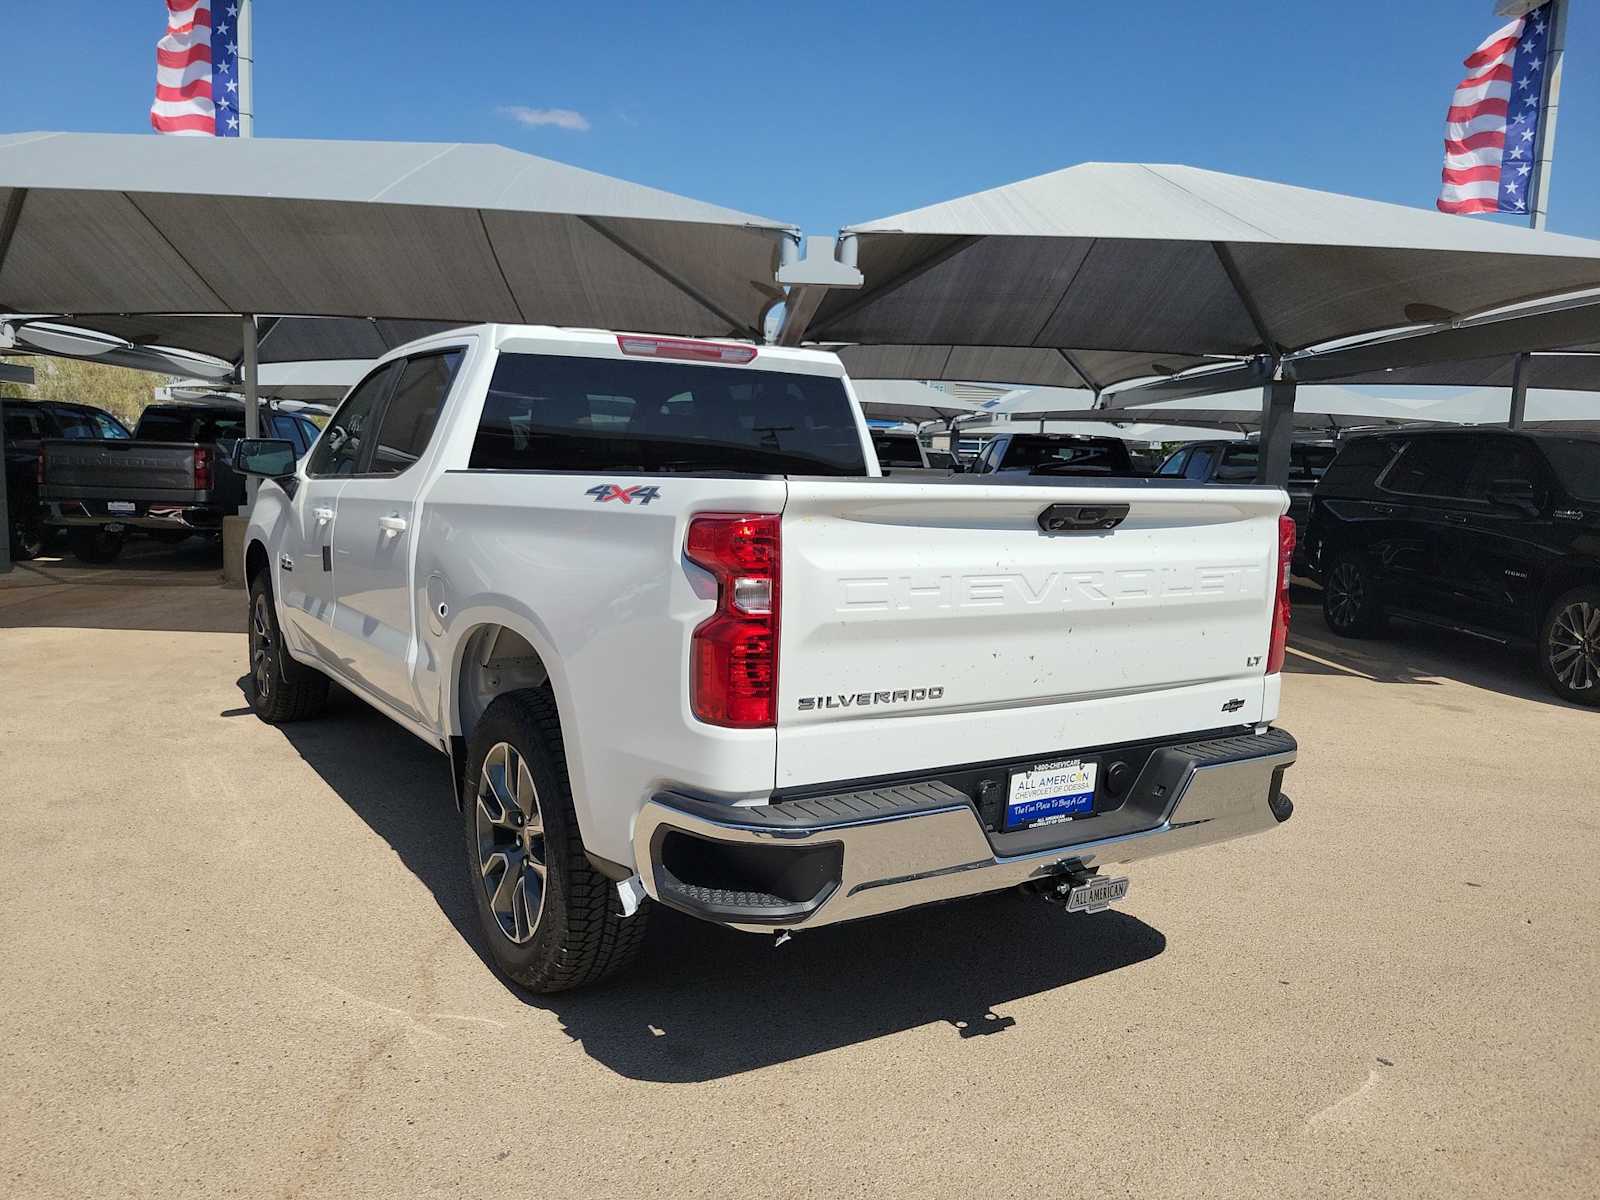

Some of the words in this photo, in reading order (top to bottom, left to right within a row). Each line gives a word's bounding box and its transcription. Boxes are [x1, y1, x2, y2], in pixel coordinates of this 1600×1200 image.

[835, 563, 1260, 613] CHEVROLET
[1246, 656, 1262, 667] LT
[798, 686, 945, 711] SILVERADO
[1015, 787, 1053, 800] CHEVROLET
[1053, 785, 1064, 793] OF
[1064, 782, 1090, 792] ODESSA
[1018, 780, 1036, 790] ALL
[1036, 801, 1050, 812] Place
[1051, 799, 1058, 808] To
[1059, 798, 1071, 809] Buy
[1071, 797, 1076, 806] A
[1077, 796, 1087, 804] Car
[1075, 892, 1087, 904] ALL
[1089, 881, 1125, 902] AMERICAN
